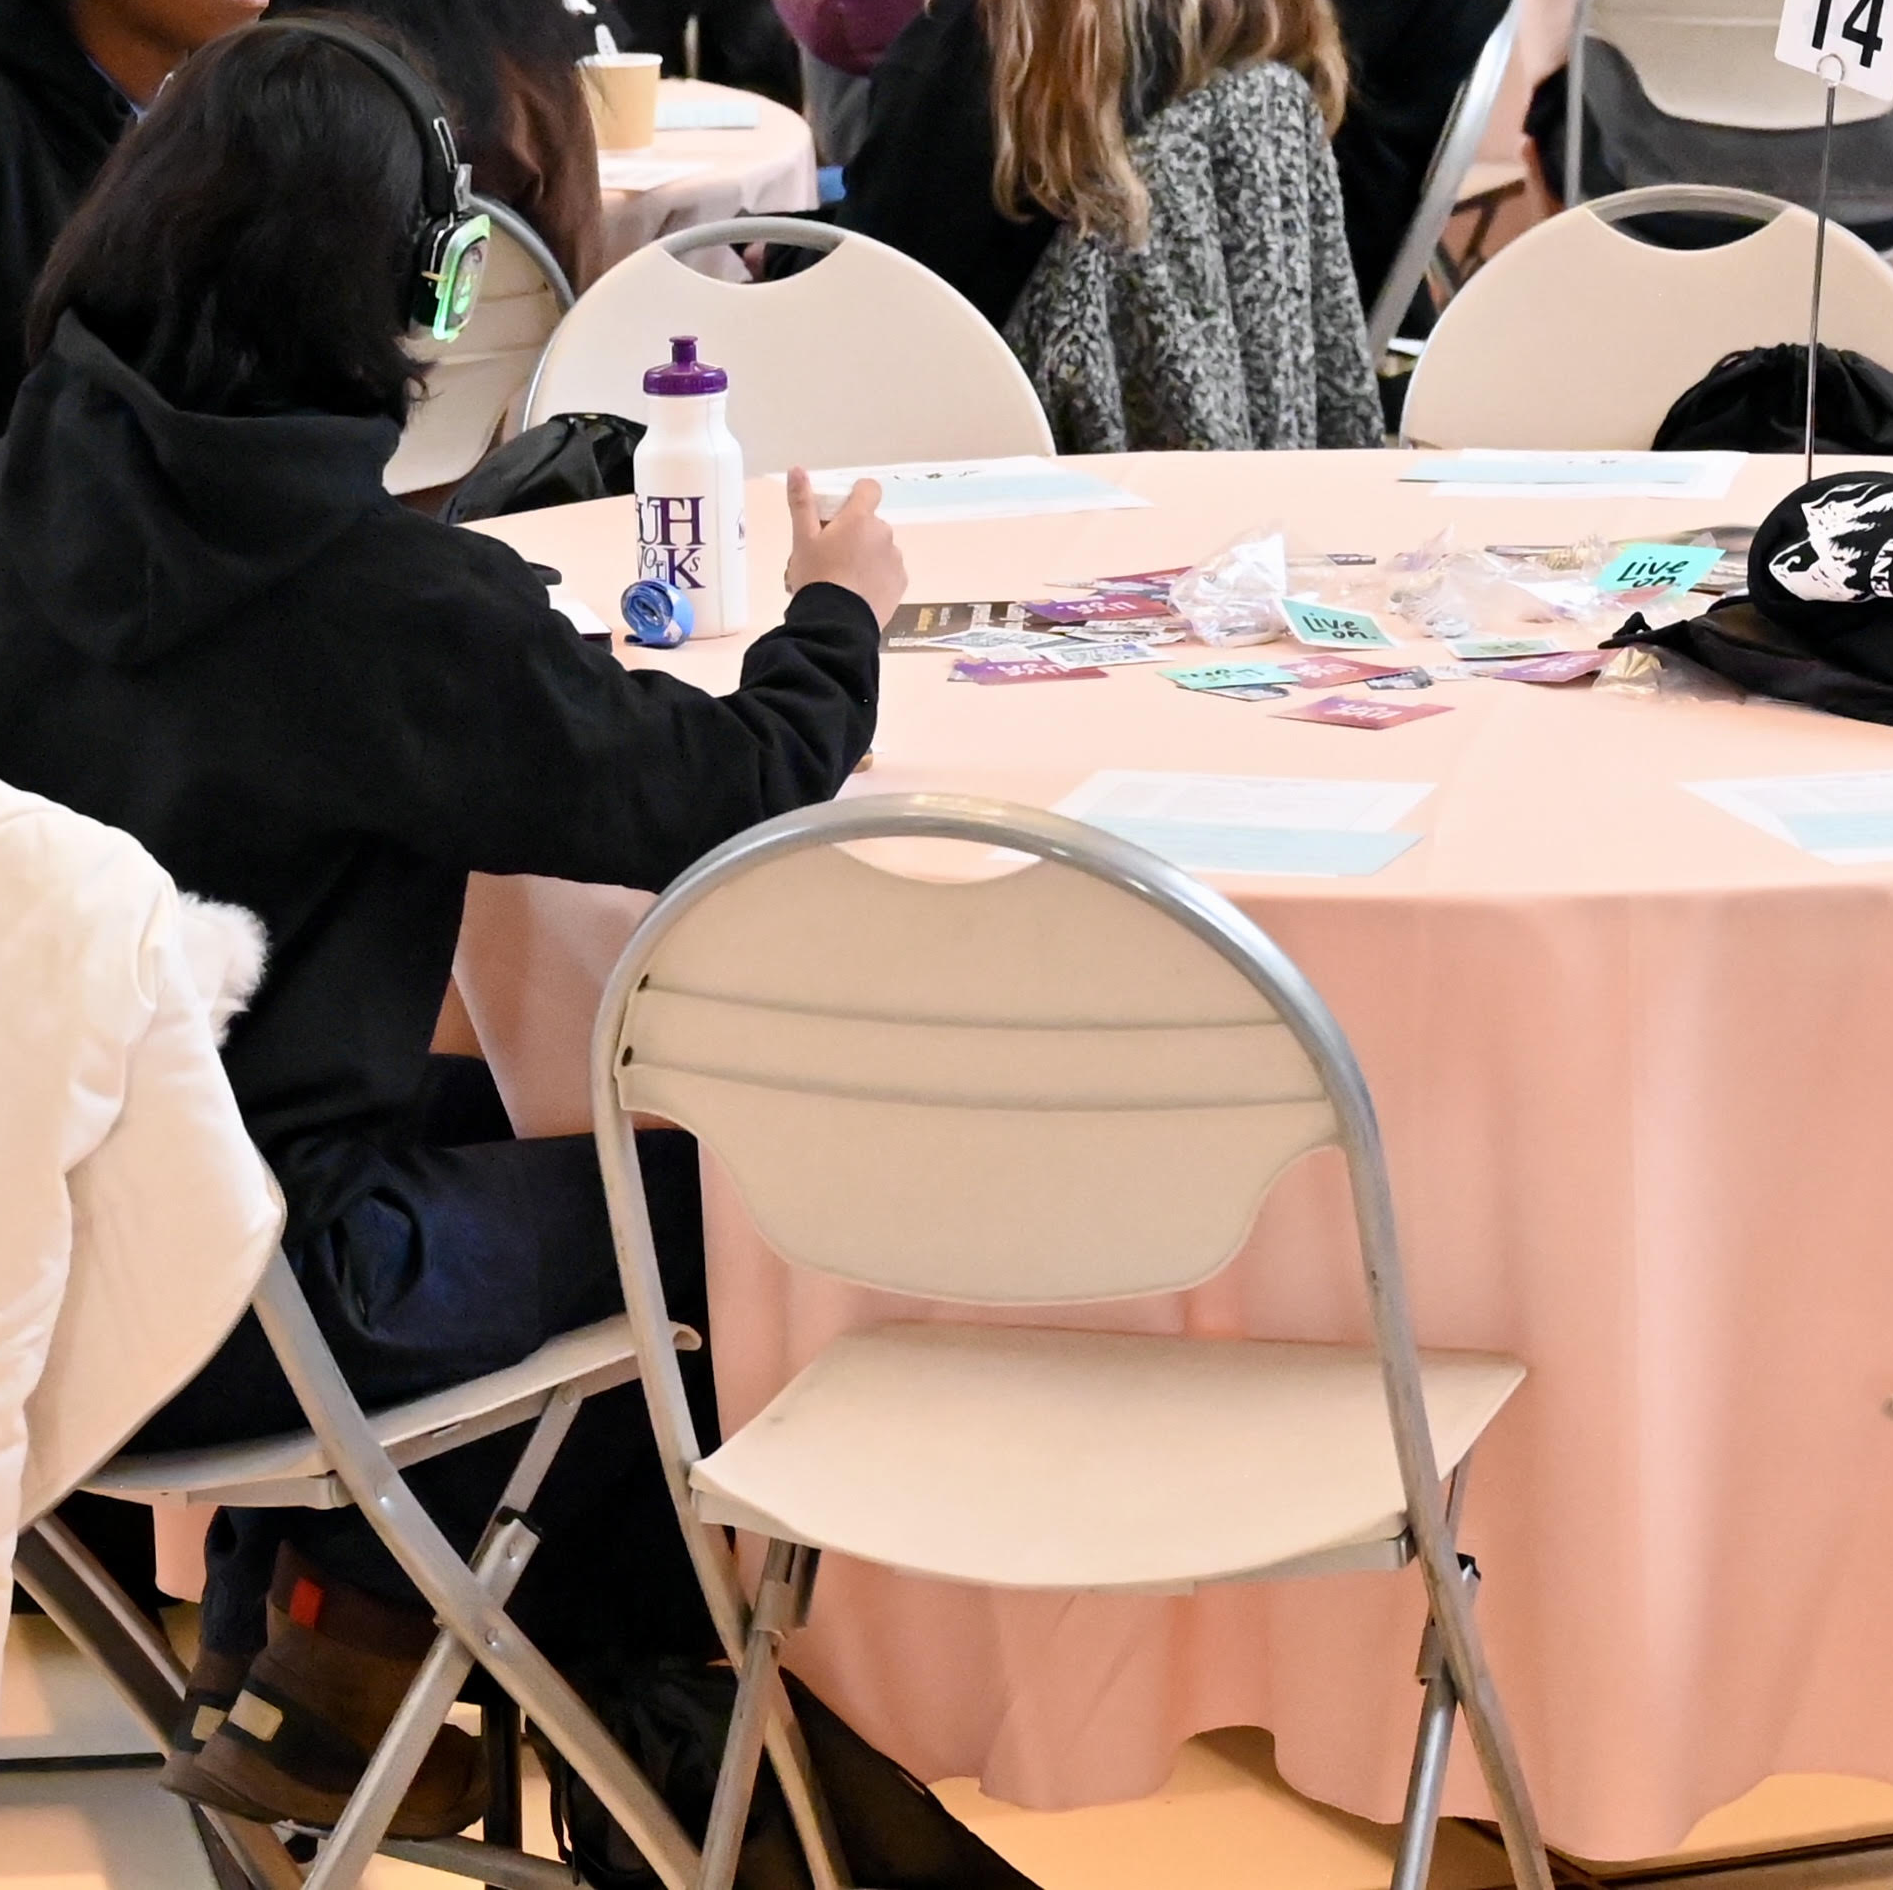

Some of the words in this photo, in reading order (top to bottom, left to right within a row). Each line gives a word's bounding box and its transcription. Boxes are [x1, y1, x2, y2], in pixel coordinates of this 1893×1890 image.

[636, 495, 707, 546] UTH
[1617, 556, 1690, 582] Live
[1301, 612, 1360, 633] Live
